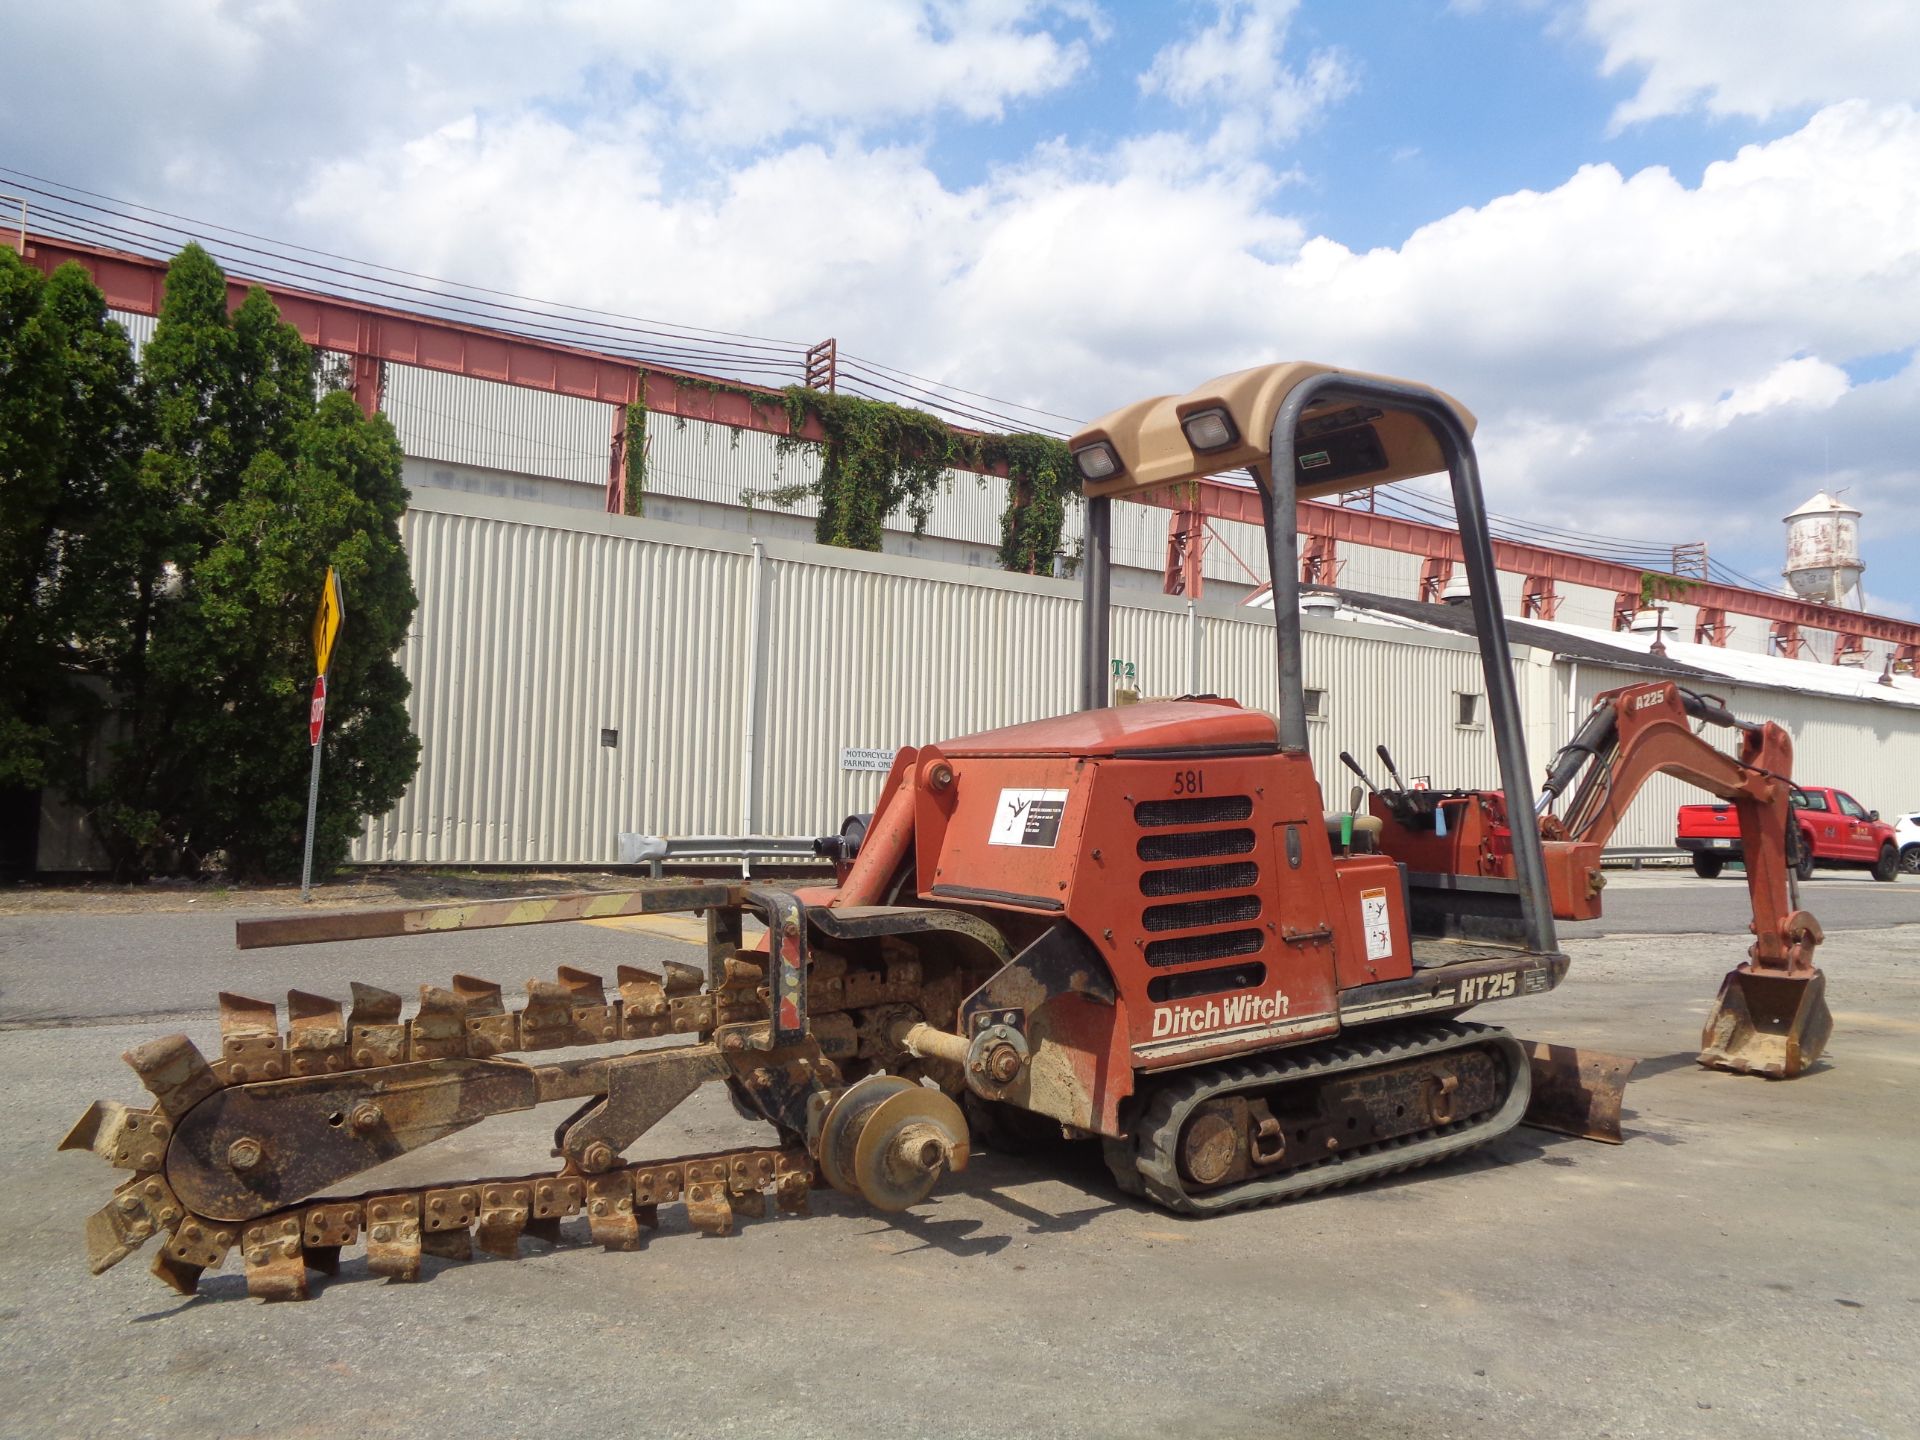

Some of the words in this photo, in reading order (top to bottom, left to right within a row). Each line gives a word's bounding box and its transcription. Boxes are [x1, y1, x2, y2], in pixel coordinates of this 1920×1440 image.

[1635, 689, 1664, 710] A225
[843, 759, 876, 768] PARKING
[846, 750, 894, 760] MOTORCYCLE
[1173, 770, 1203, 795] 581
[1459, 971, 1517, 1004] HT25
[1152, 1001, 1220, 1038] Ditch
[1223, 989, 1289, 1025] Witch
